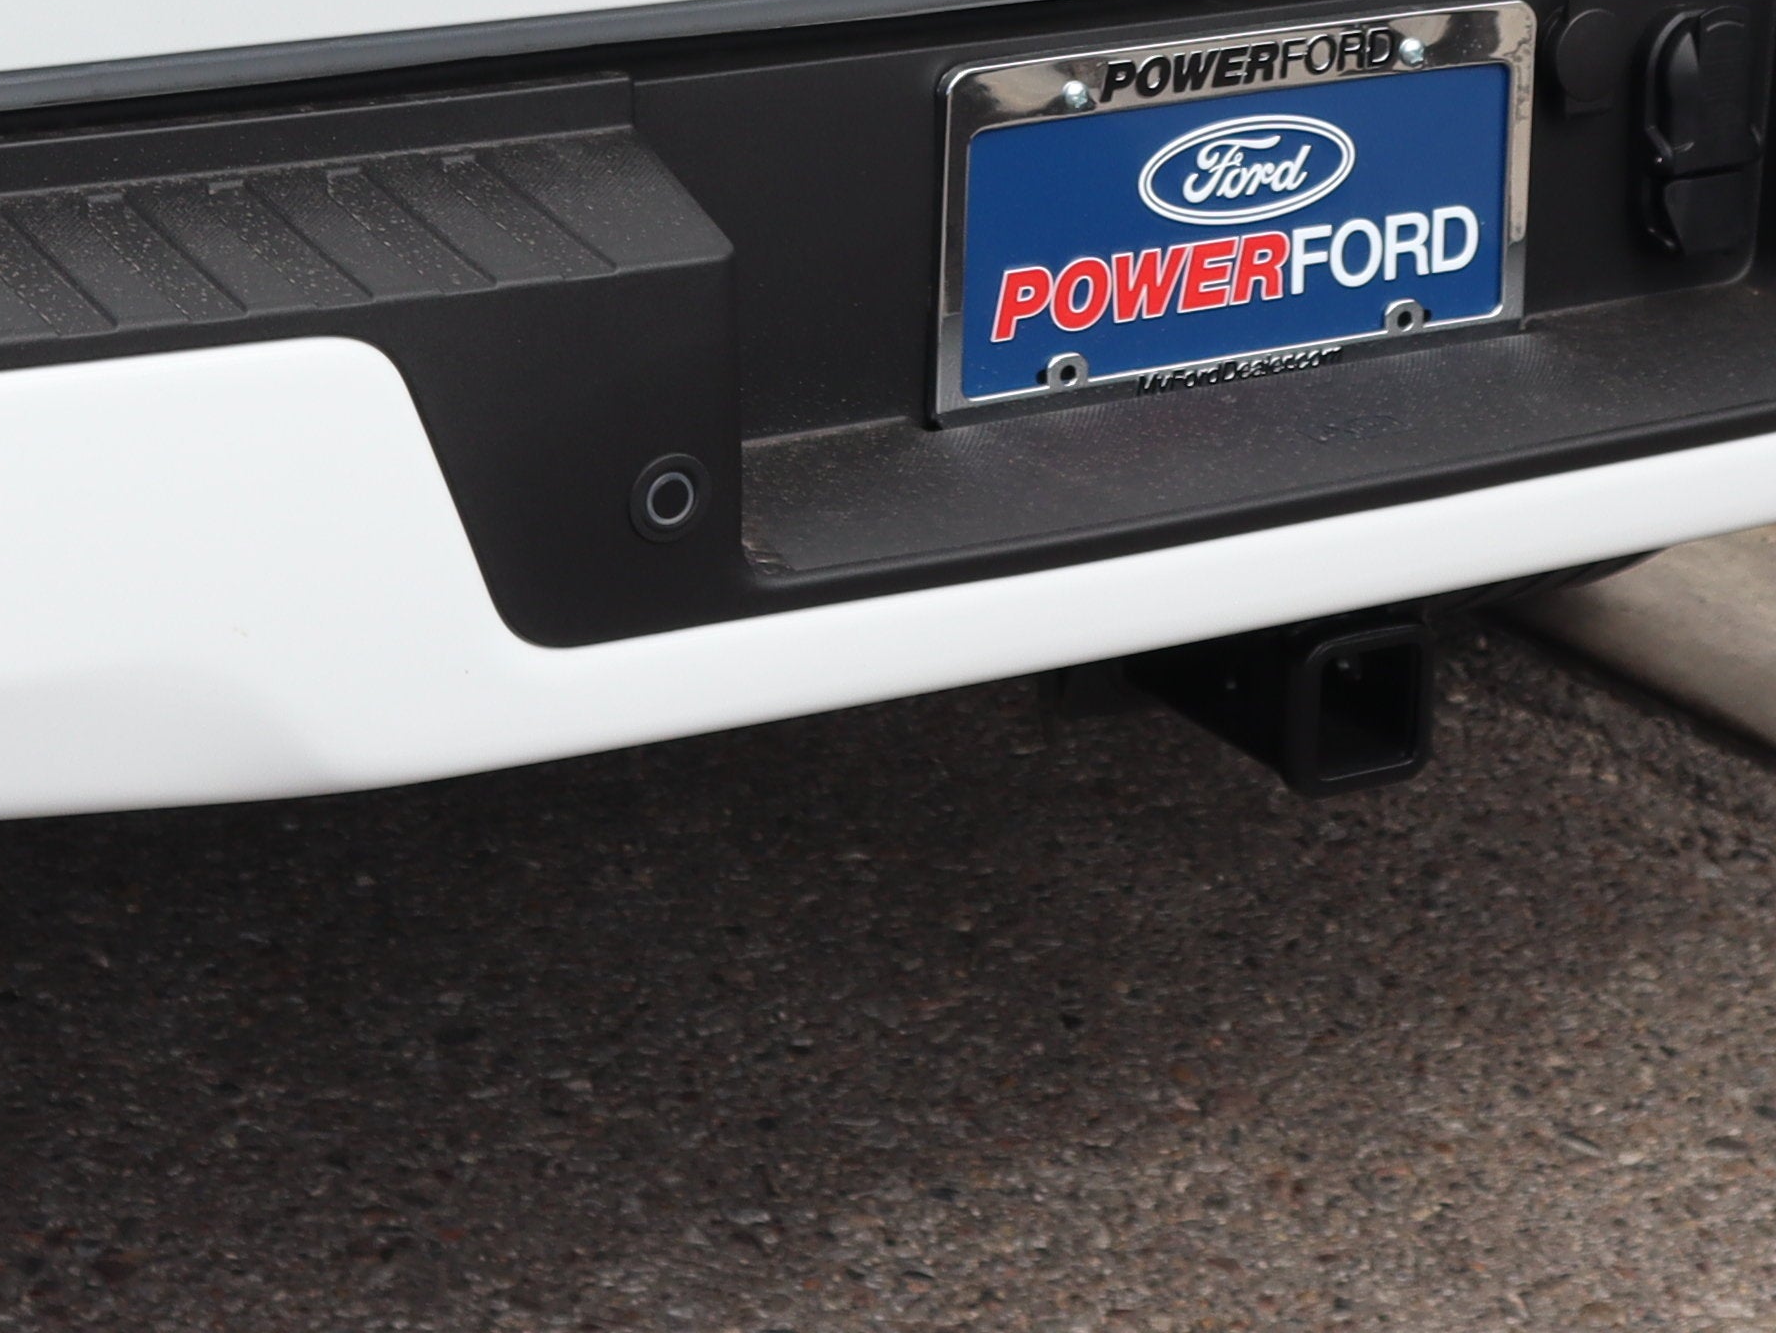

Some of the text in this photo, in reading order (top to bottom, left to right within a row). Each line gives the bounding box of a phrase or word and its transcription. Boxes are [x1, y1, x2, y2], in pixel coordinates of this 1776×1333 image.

[1099, 27, 1396, 103] POWERFORD
[1181, 135, 1312, 204] Ford
[990, 205, 1480, 343] POWERFORD
